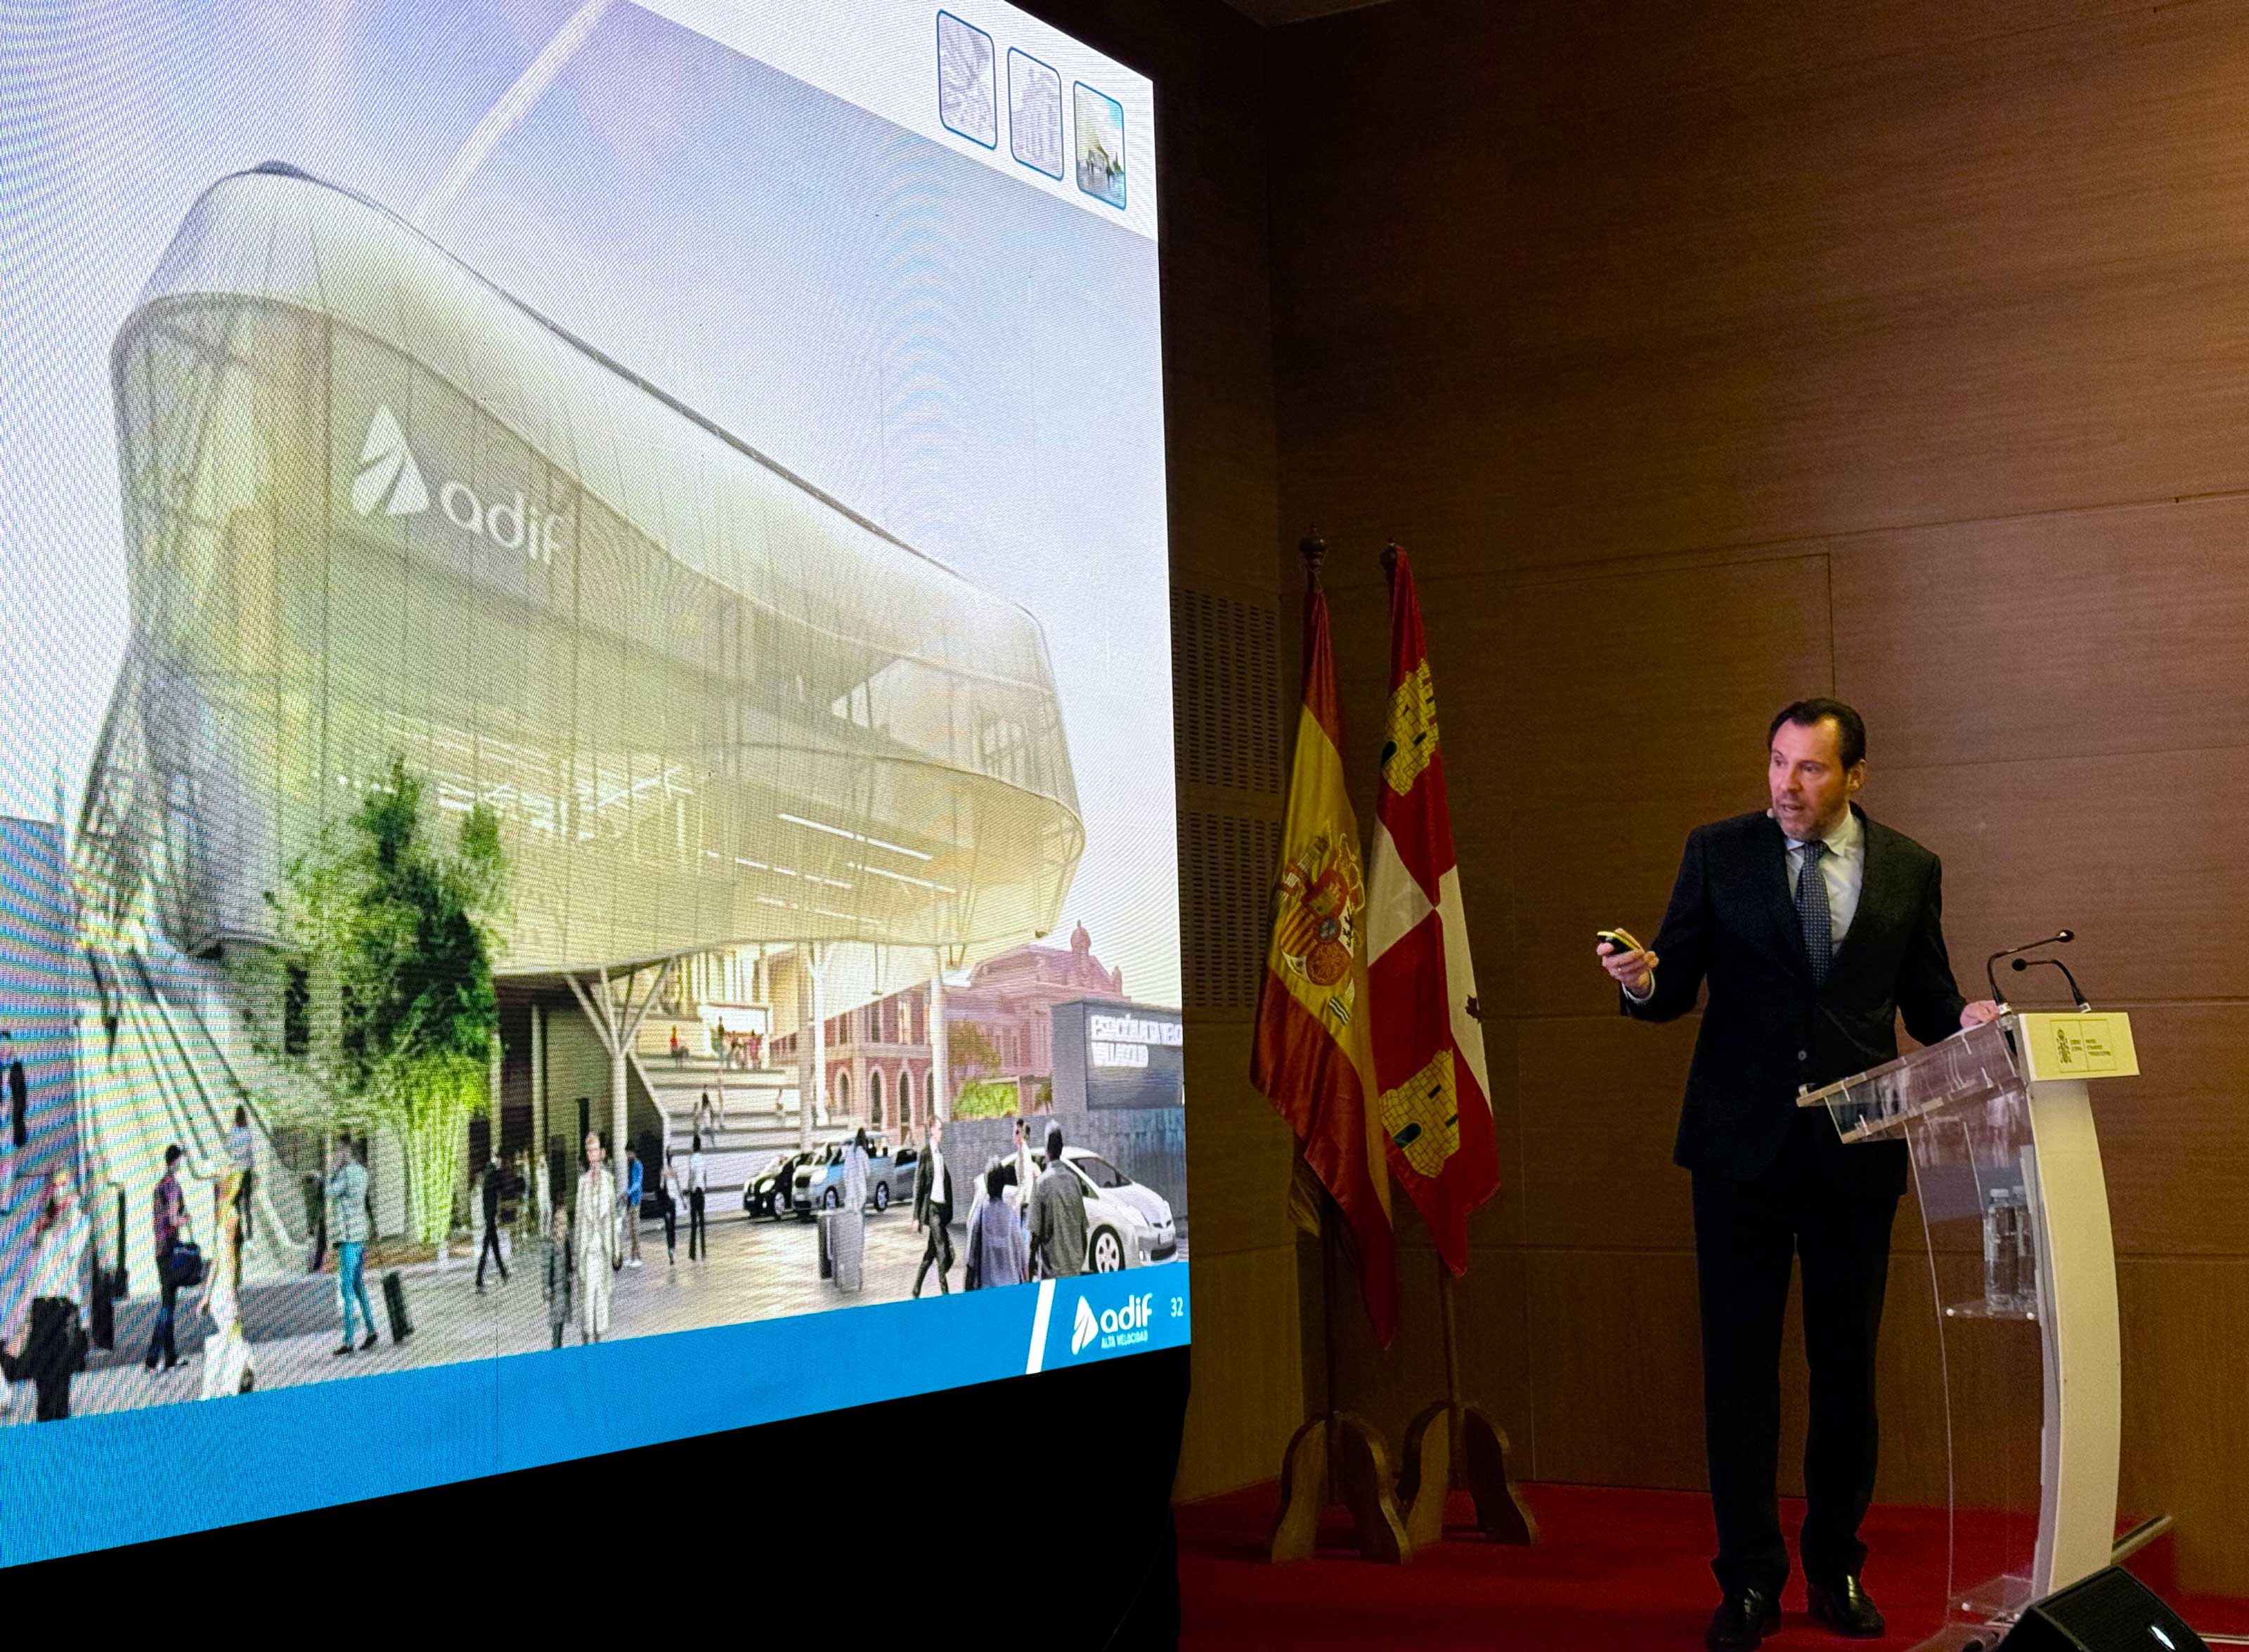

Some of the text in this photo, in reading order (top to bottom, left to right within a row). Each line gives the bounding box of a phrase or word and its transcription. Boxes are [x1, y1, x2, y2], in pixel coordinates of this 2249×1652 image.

[441, 481, 564, 564] adif
[1101, 1293, 1153, 1333] adif
[1171, 1297, 1184, 1318] 32
